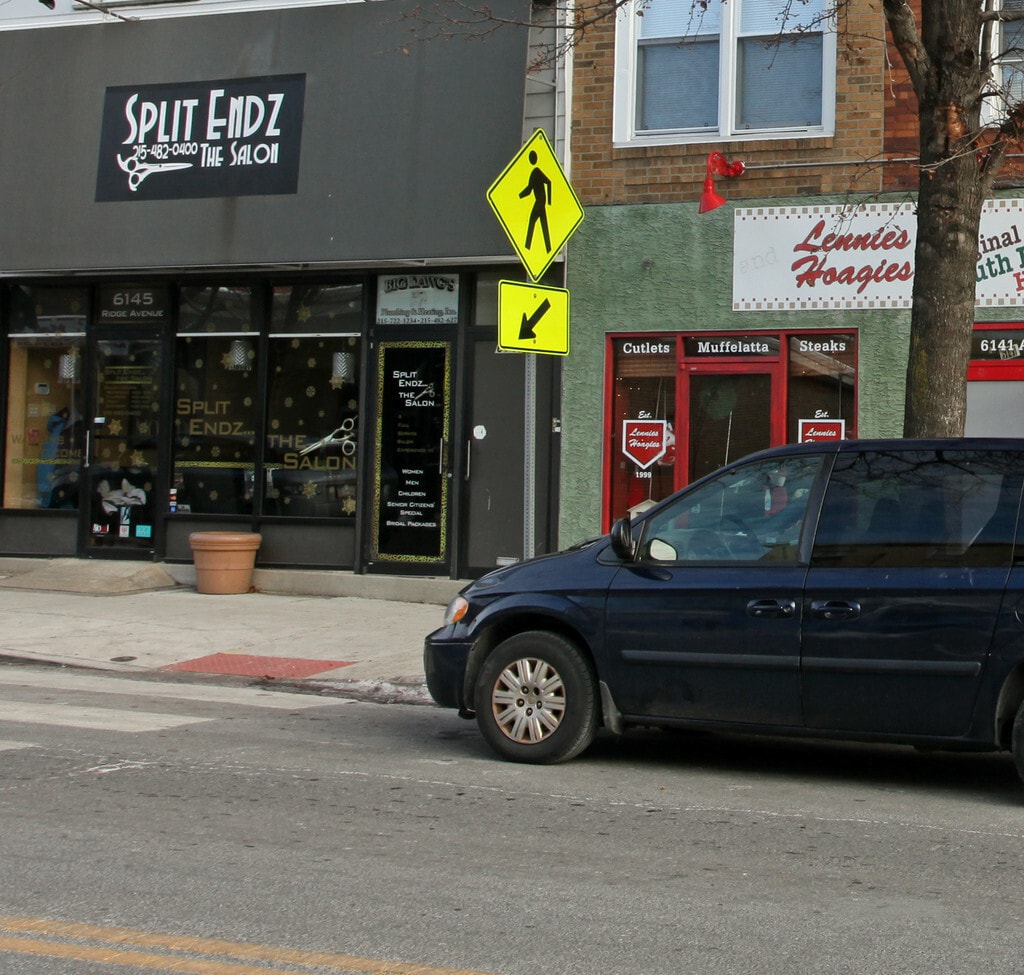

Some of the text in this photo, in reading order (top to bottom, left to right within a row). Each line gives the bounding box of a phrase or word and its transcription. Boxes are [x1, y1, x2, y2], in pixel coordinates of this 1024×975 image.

[132, 142, 198, 160] 215-482-0400
[793, 219, 912, 252] Lennies
[976, 225, 1022, 262] inal
[791, 254, 914, 294] Hoagies
[384, 276, 408, 293] BIG
[113, 292, 153, 305] 6145
[623, 342, 670, 354] Cutlets
[698, 340, 769, 353] Muffelatta
[799, 339, 846, 352] Steaks
[980, 340, 1015, 351] 6141
[629, 428, 659, 437] Lennies
[805, 427, 837, 437] Lennies
[628, 438, 660, 450] Hoagies
